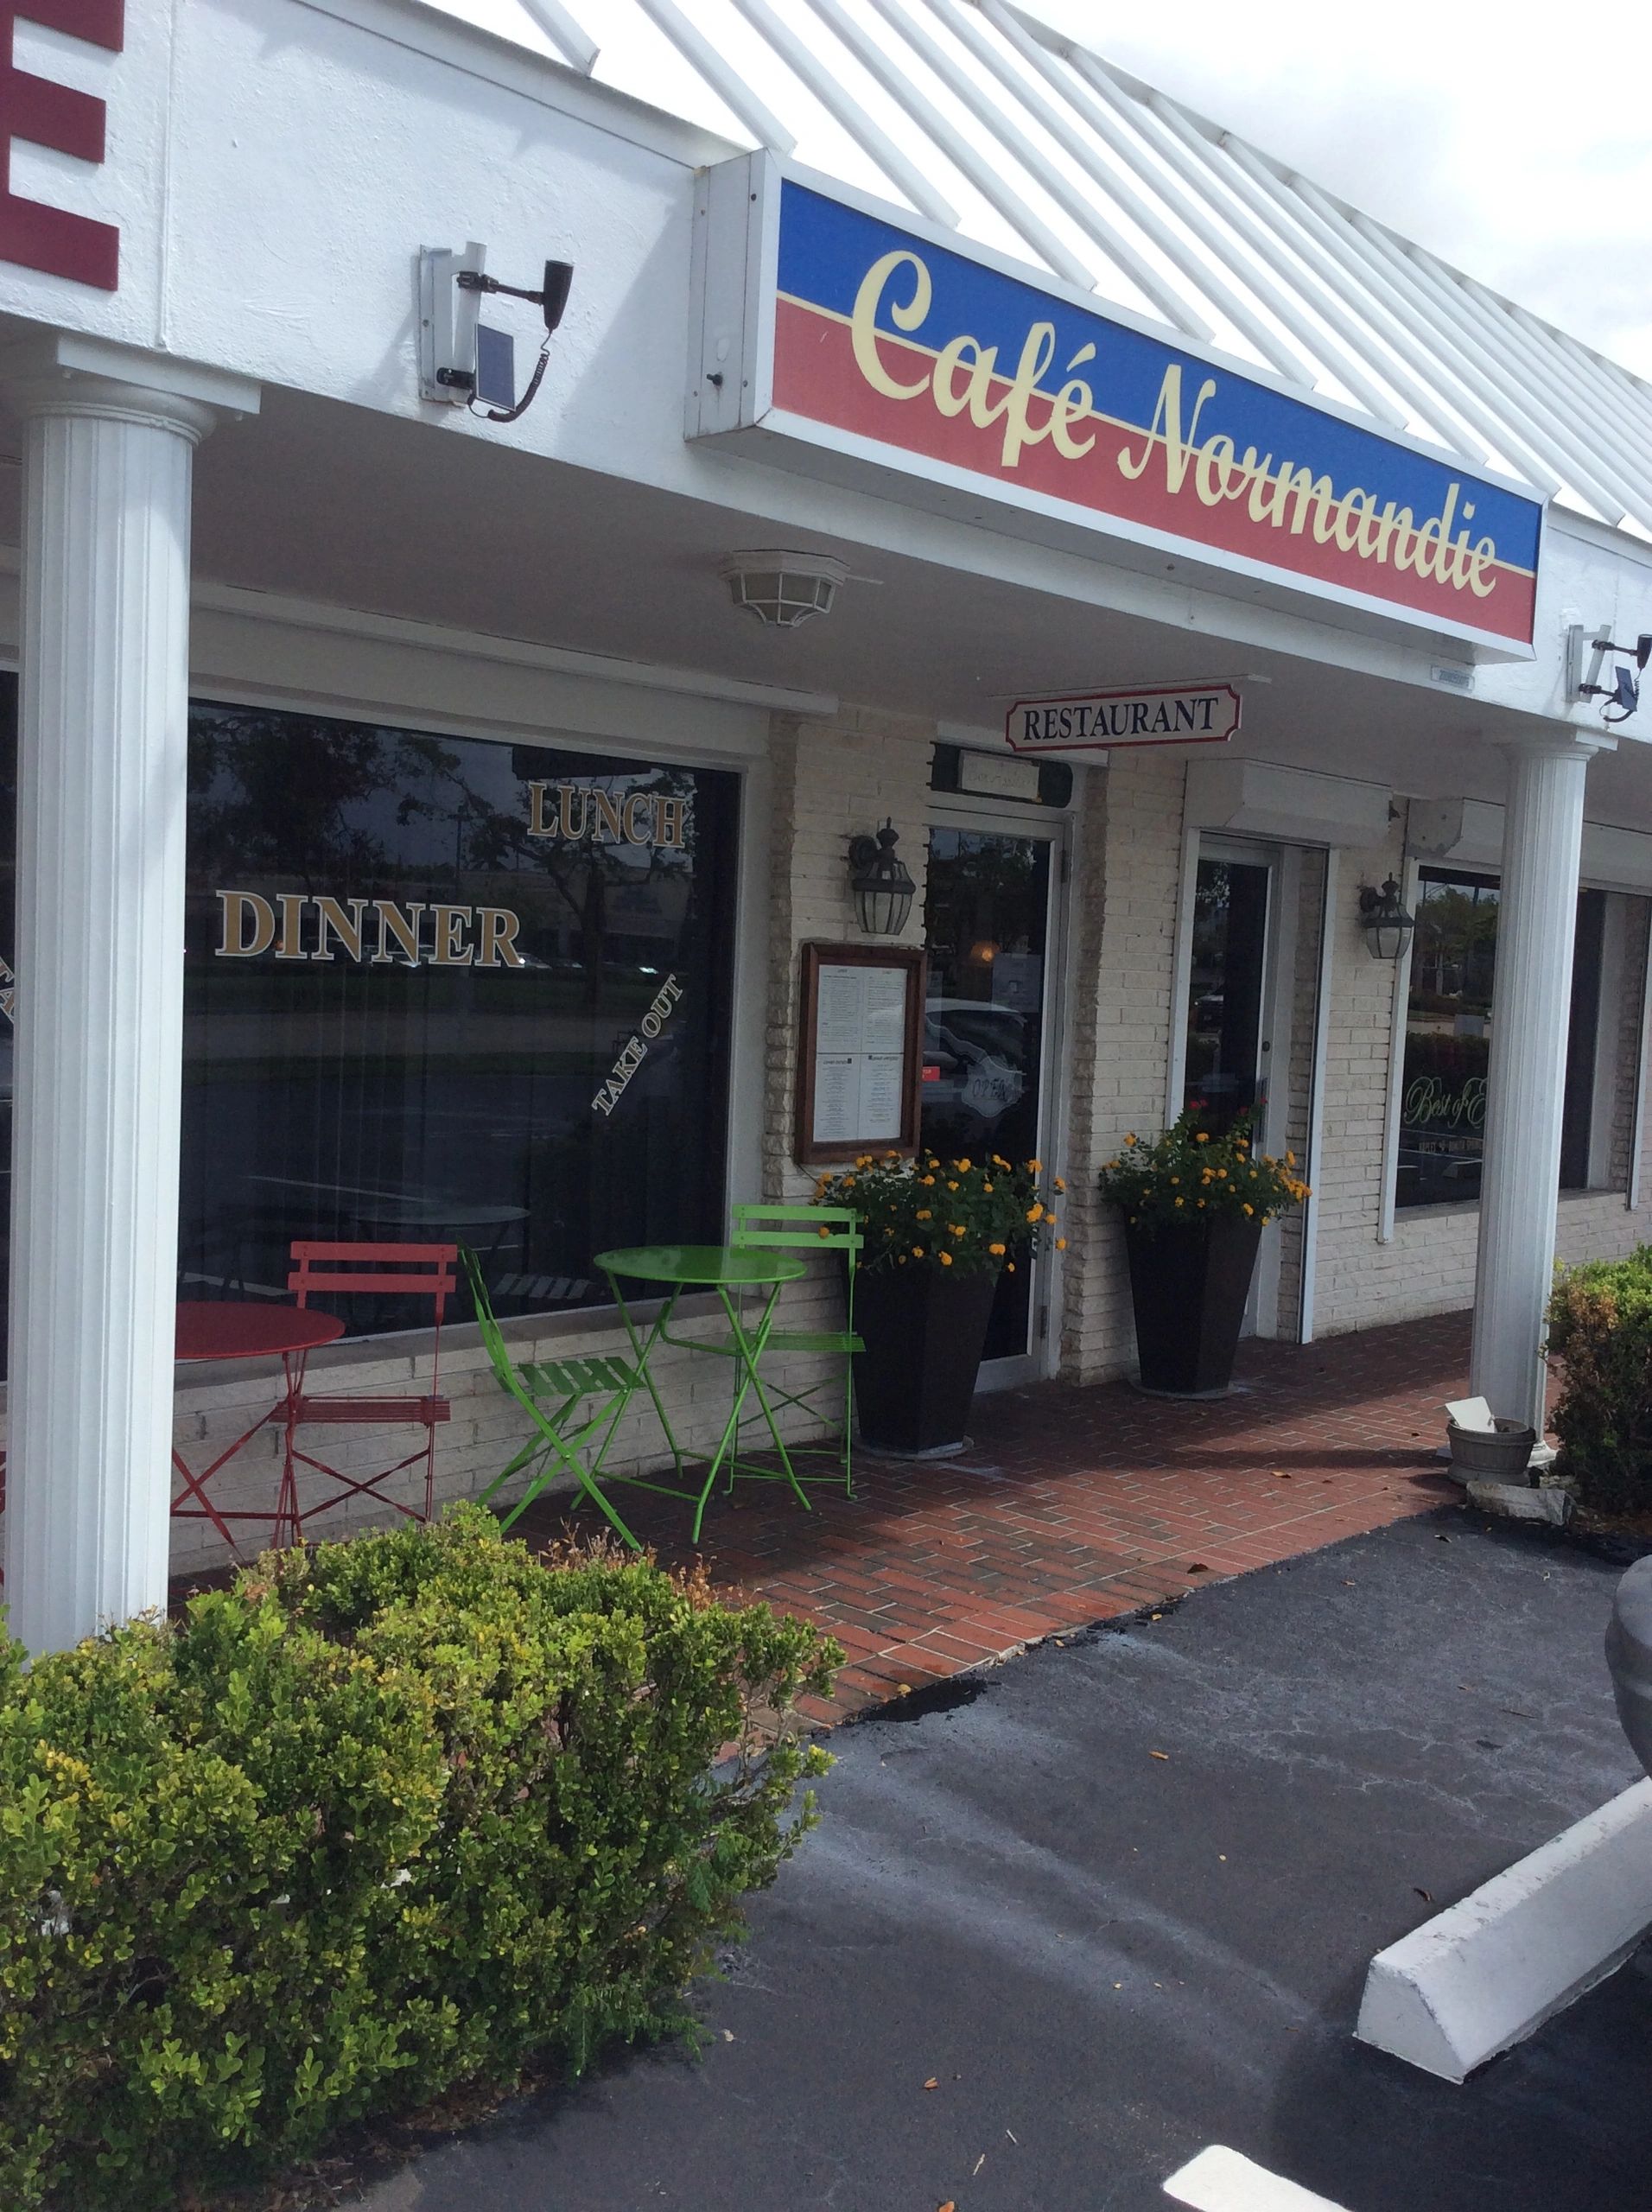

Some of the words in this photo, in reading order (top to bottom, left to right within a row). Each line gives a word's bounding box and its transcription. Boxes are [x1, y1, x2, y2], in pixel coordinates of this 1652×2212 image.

[852, 250, 1096, 467] Café
[1117, 364, 1496, 598] Normandie
[1023, 697, 1219, 741] RESTAURANT
[527, 781, 686, 849] LUNCH
[214, 889, 524, 968] DINNER
[591, 1035, 649, 1116] TAKE
[641, 973, 683, 1038] OUT
[1404, 1077, 1452, 1124] Best
[1447, 1084, 1470, 1128] of
